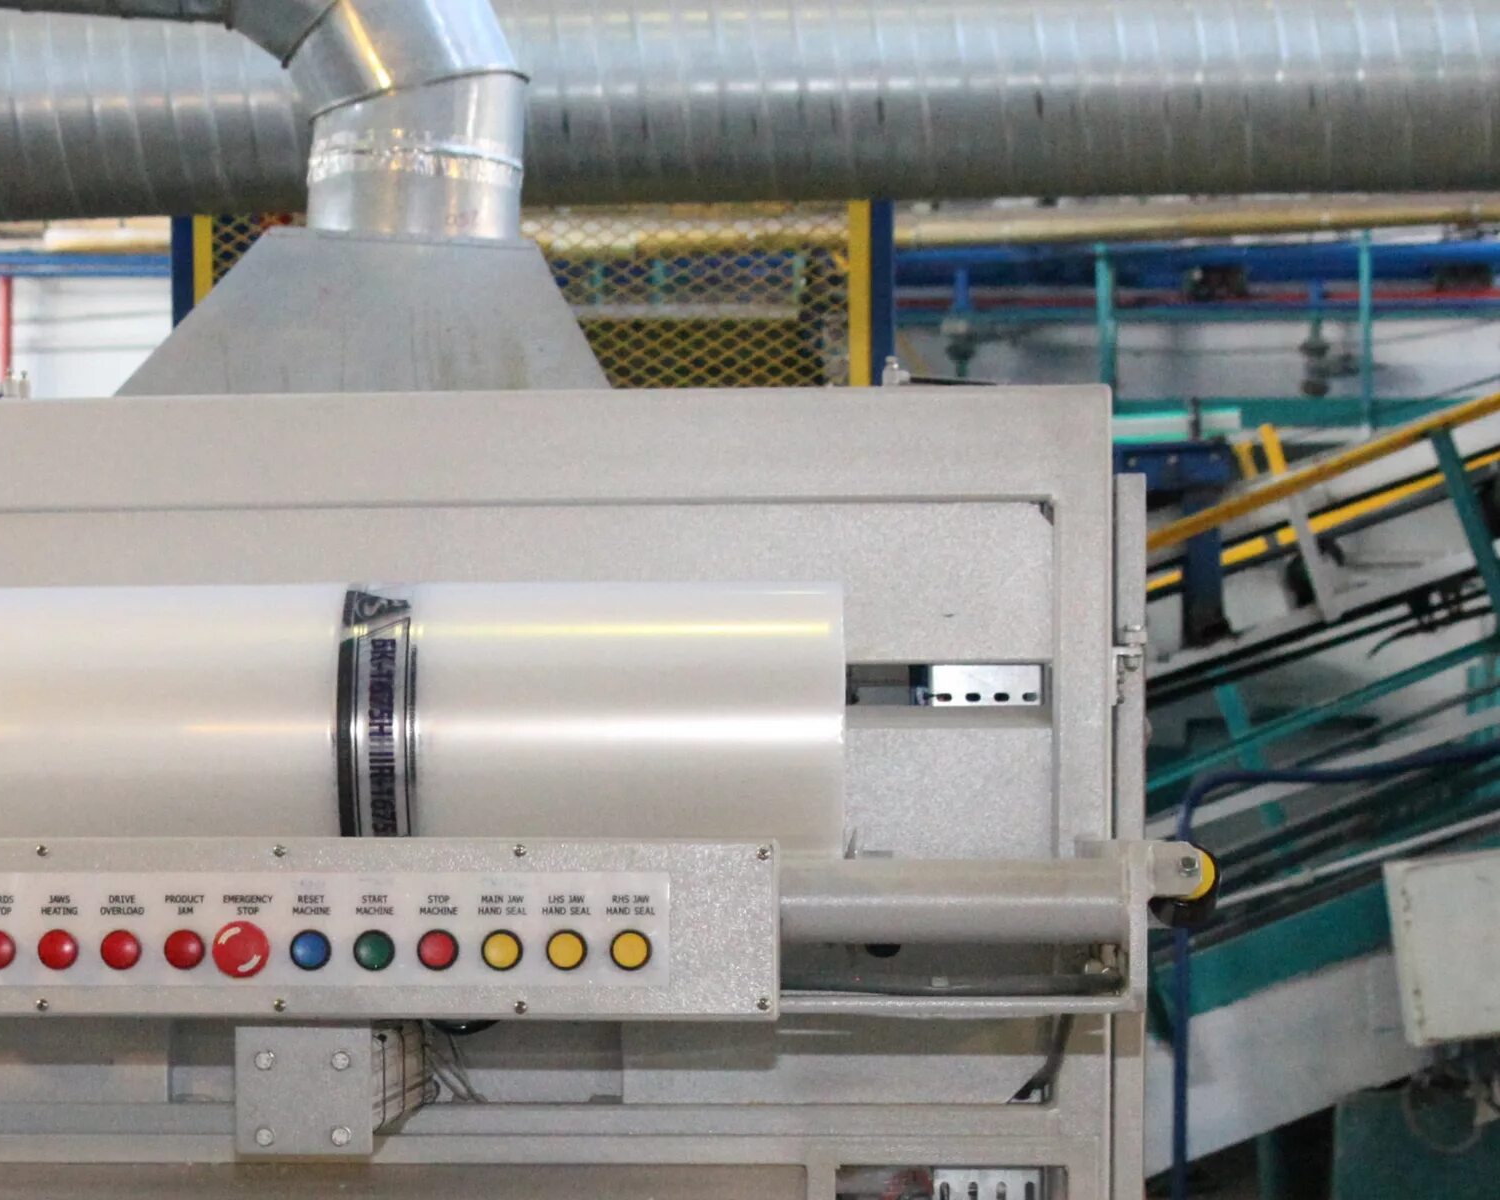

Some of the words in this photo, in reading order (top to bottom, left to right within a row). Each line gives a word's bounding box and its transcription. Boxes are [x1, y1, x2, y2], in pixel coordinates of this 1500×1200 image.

[49, 895, 71, 904] JAWS
[109, 895, 136, 904] DRIVE
[165, 895, 204, 904] PRODUCT
[223, 895, 273, 904] EMERGENCY
[298, 895, 325, 904] RESET
[362, 895, 388, 904] START
[428, 895, 451, 904] STOP
[481, 895, 503, 904] MAIN
[508, 895, 525, 904] JAW
[548, 895, 565, 904] LHS
[568, 895, 585, 904] JAW
[612, 895, 630, 904] RHS
[633, 895, 650, 904] JAW
[41, 907, 78, 916] HEATING
[100, 907, 145, 916] OVERLOAD
[177, 907, 194, 916] JAM
[237, 907, 259, 916] STOP
[292, 907, 331, 916] MACHINE
[356, 907, 394, 916] MACHINE
[419, 907, 458, 916] MACHINE
[478, 907, 502, 916] HAND
[506, 907, 527, 916] SEAL
[542, 907, 566, 916] HAND
[570, 907, 591, 916] SEAL
[606, 907, 631, 916] HAND
[634, 907, 656, 916] SEAL
